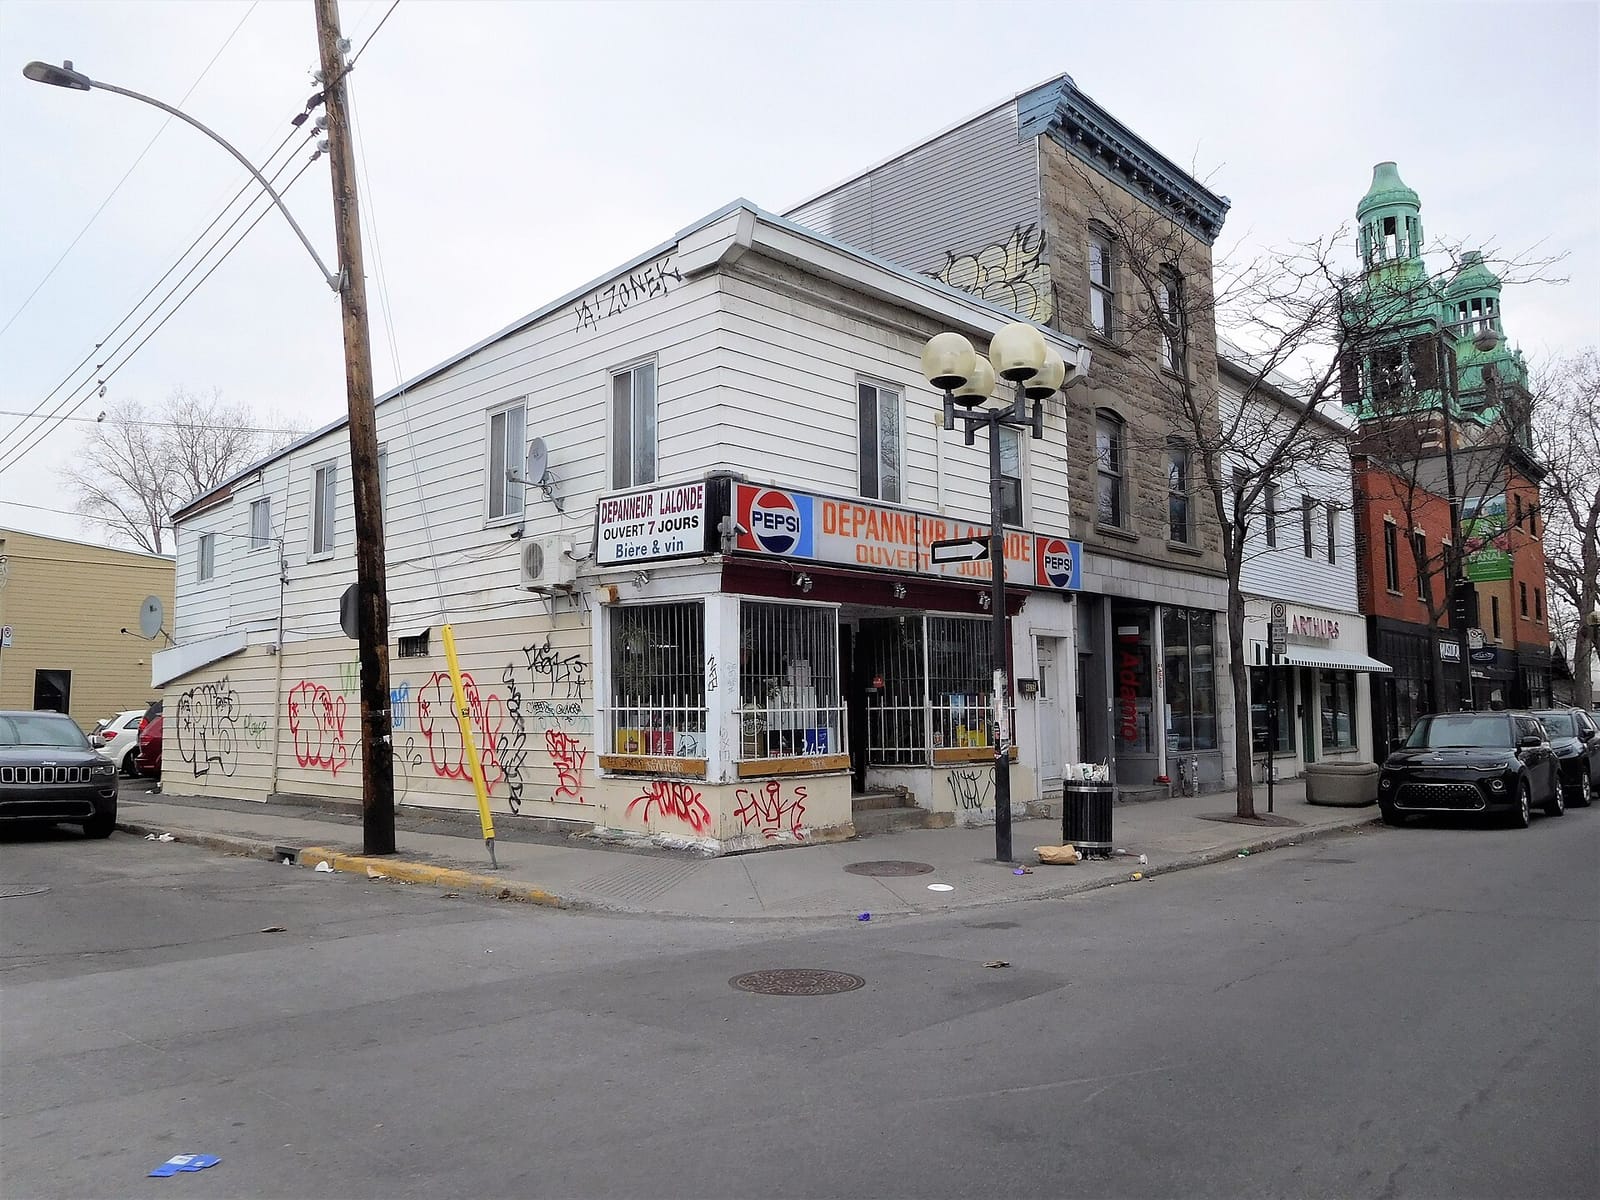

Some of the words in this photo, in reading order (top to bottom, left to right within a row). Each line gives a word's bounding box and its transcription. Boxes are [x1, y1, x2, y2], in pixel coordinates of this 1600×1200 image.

[601, 494, 654, 525] DEPANNEUR
[660, 485, 703, 514] LALONDE
[603, 523, 645, 541] OUVERT
[648, 521, 656, 535] 7
[658, 515, 699, 533] JOURS
[752, 510, 800, 533] PEPSI
[823, 502, 946, 548] DEPANNEUR
[615, 541, 648, 559] Bière
[652, 540, 661, 555] &
[664, 536, 684, 552] vin
[856, 543, 930, 571] OUVERT
[1044, 554, 1073, 572] PEPSI
[1292, 614, 1340, 639] ARTHURS
